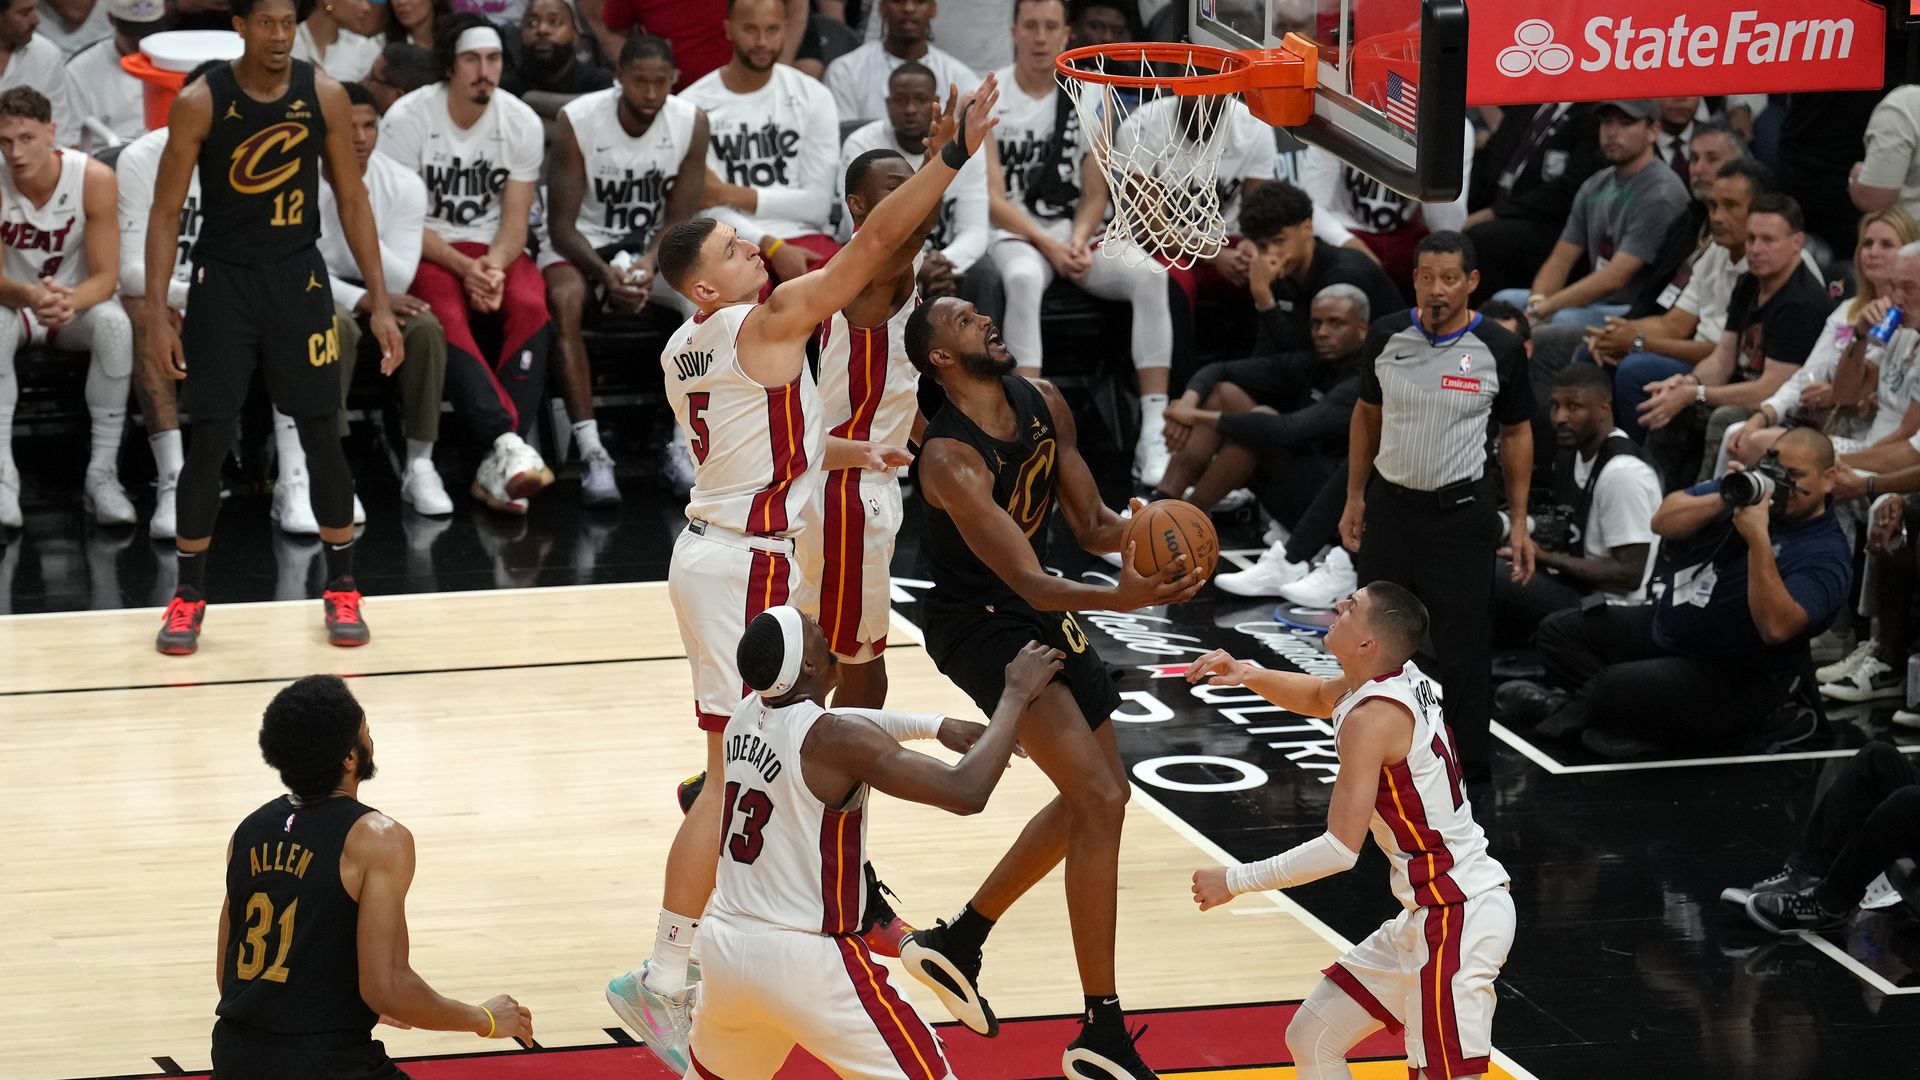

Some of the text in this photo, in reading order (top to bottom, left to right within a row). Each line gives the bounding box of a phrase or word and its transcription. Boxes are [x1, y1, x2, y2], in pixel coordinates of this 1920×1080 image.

[710, 117, 799, 161] white
[426, 154, 510, 195] white
[725, 156, 789, 188] hot
[270, 188, 304, 226] 12
[0, 215, 76, 253] HEAT
[1442, 377, 1480, 391] Emirates
[686, 392, 711, 466] 5
[726, 734, 782, 784] ADEBAYO
[719, 781, 774, 865] 13
[250, 841, 314, 879] ALLEN
[237, 892, 298, 983] 31
